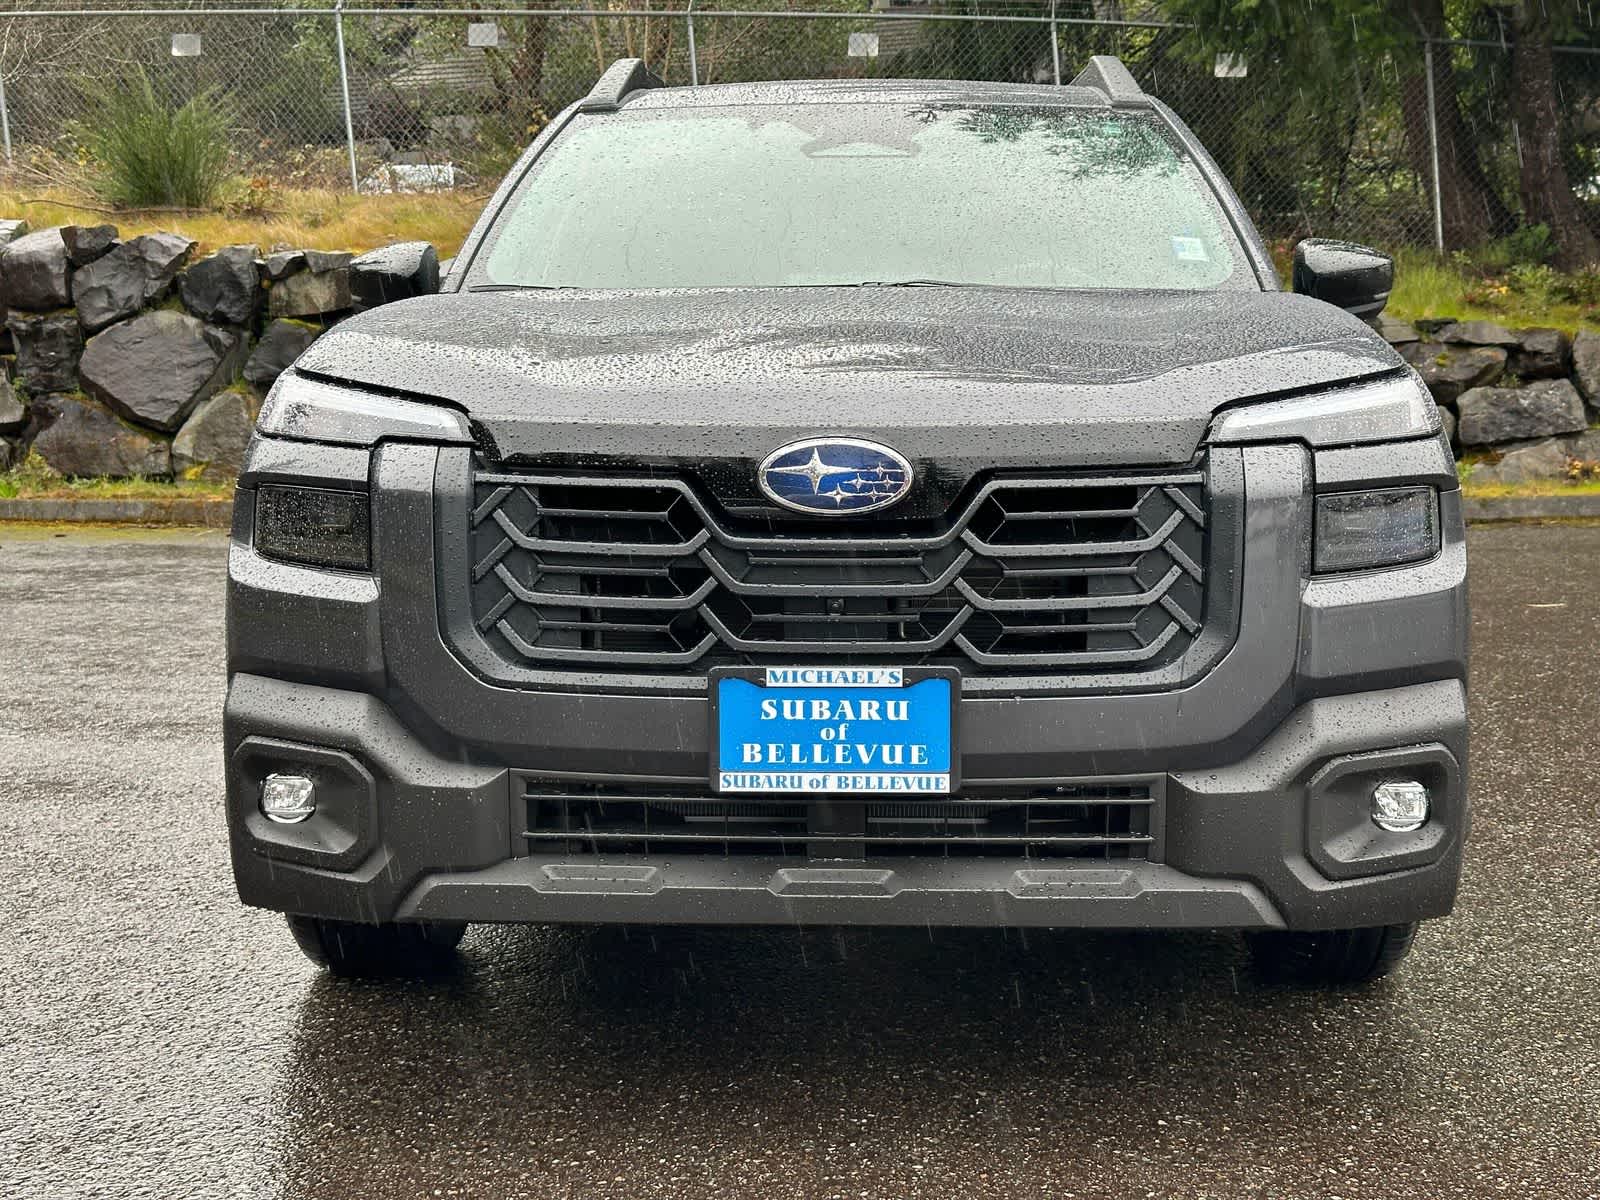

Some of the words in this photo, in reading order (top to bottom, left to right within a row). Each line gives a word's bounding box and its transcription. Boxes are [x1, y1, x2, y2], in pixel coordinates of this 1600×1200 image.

[768, 669, 901, 685] MICHAEL'S
[760, 699, 911, 721] SUBARU
[819, 723, 849, 741] of
[742, 743, 928, 765] BELLEVUE
[721, 774, 803, 789] SUBARU
[808, 774, 829, 789] of
[836, 775, 947, 791] BELLEVUE
